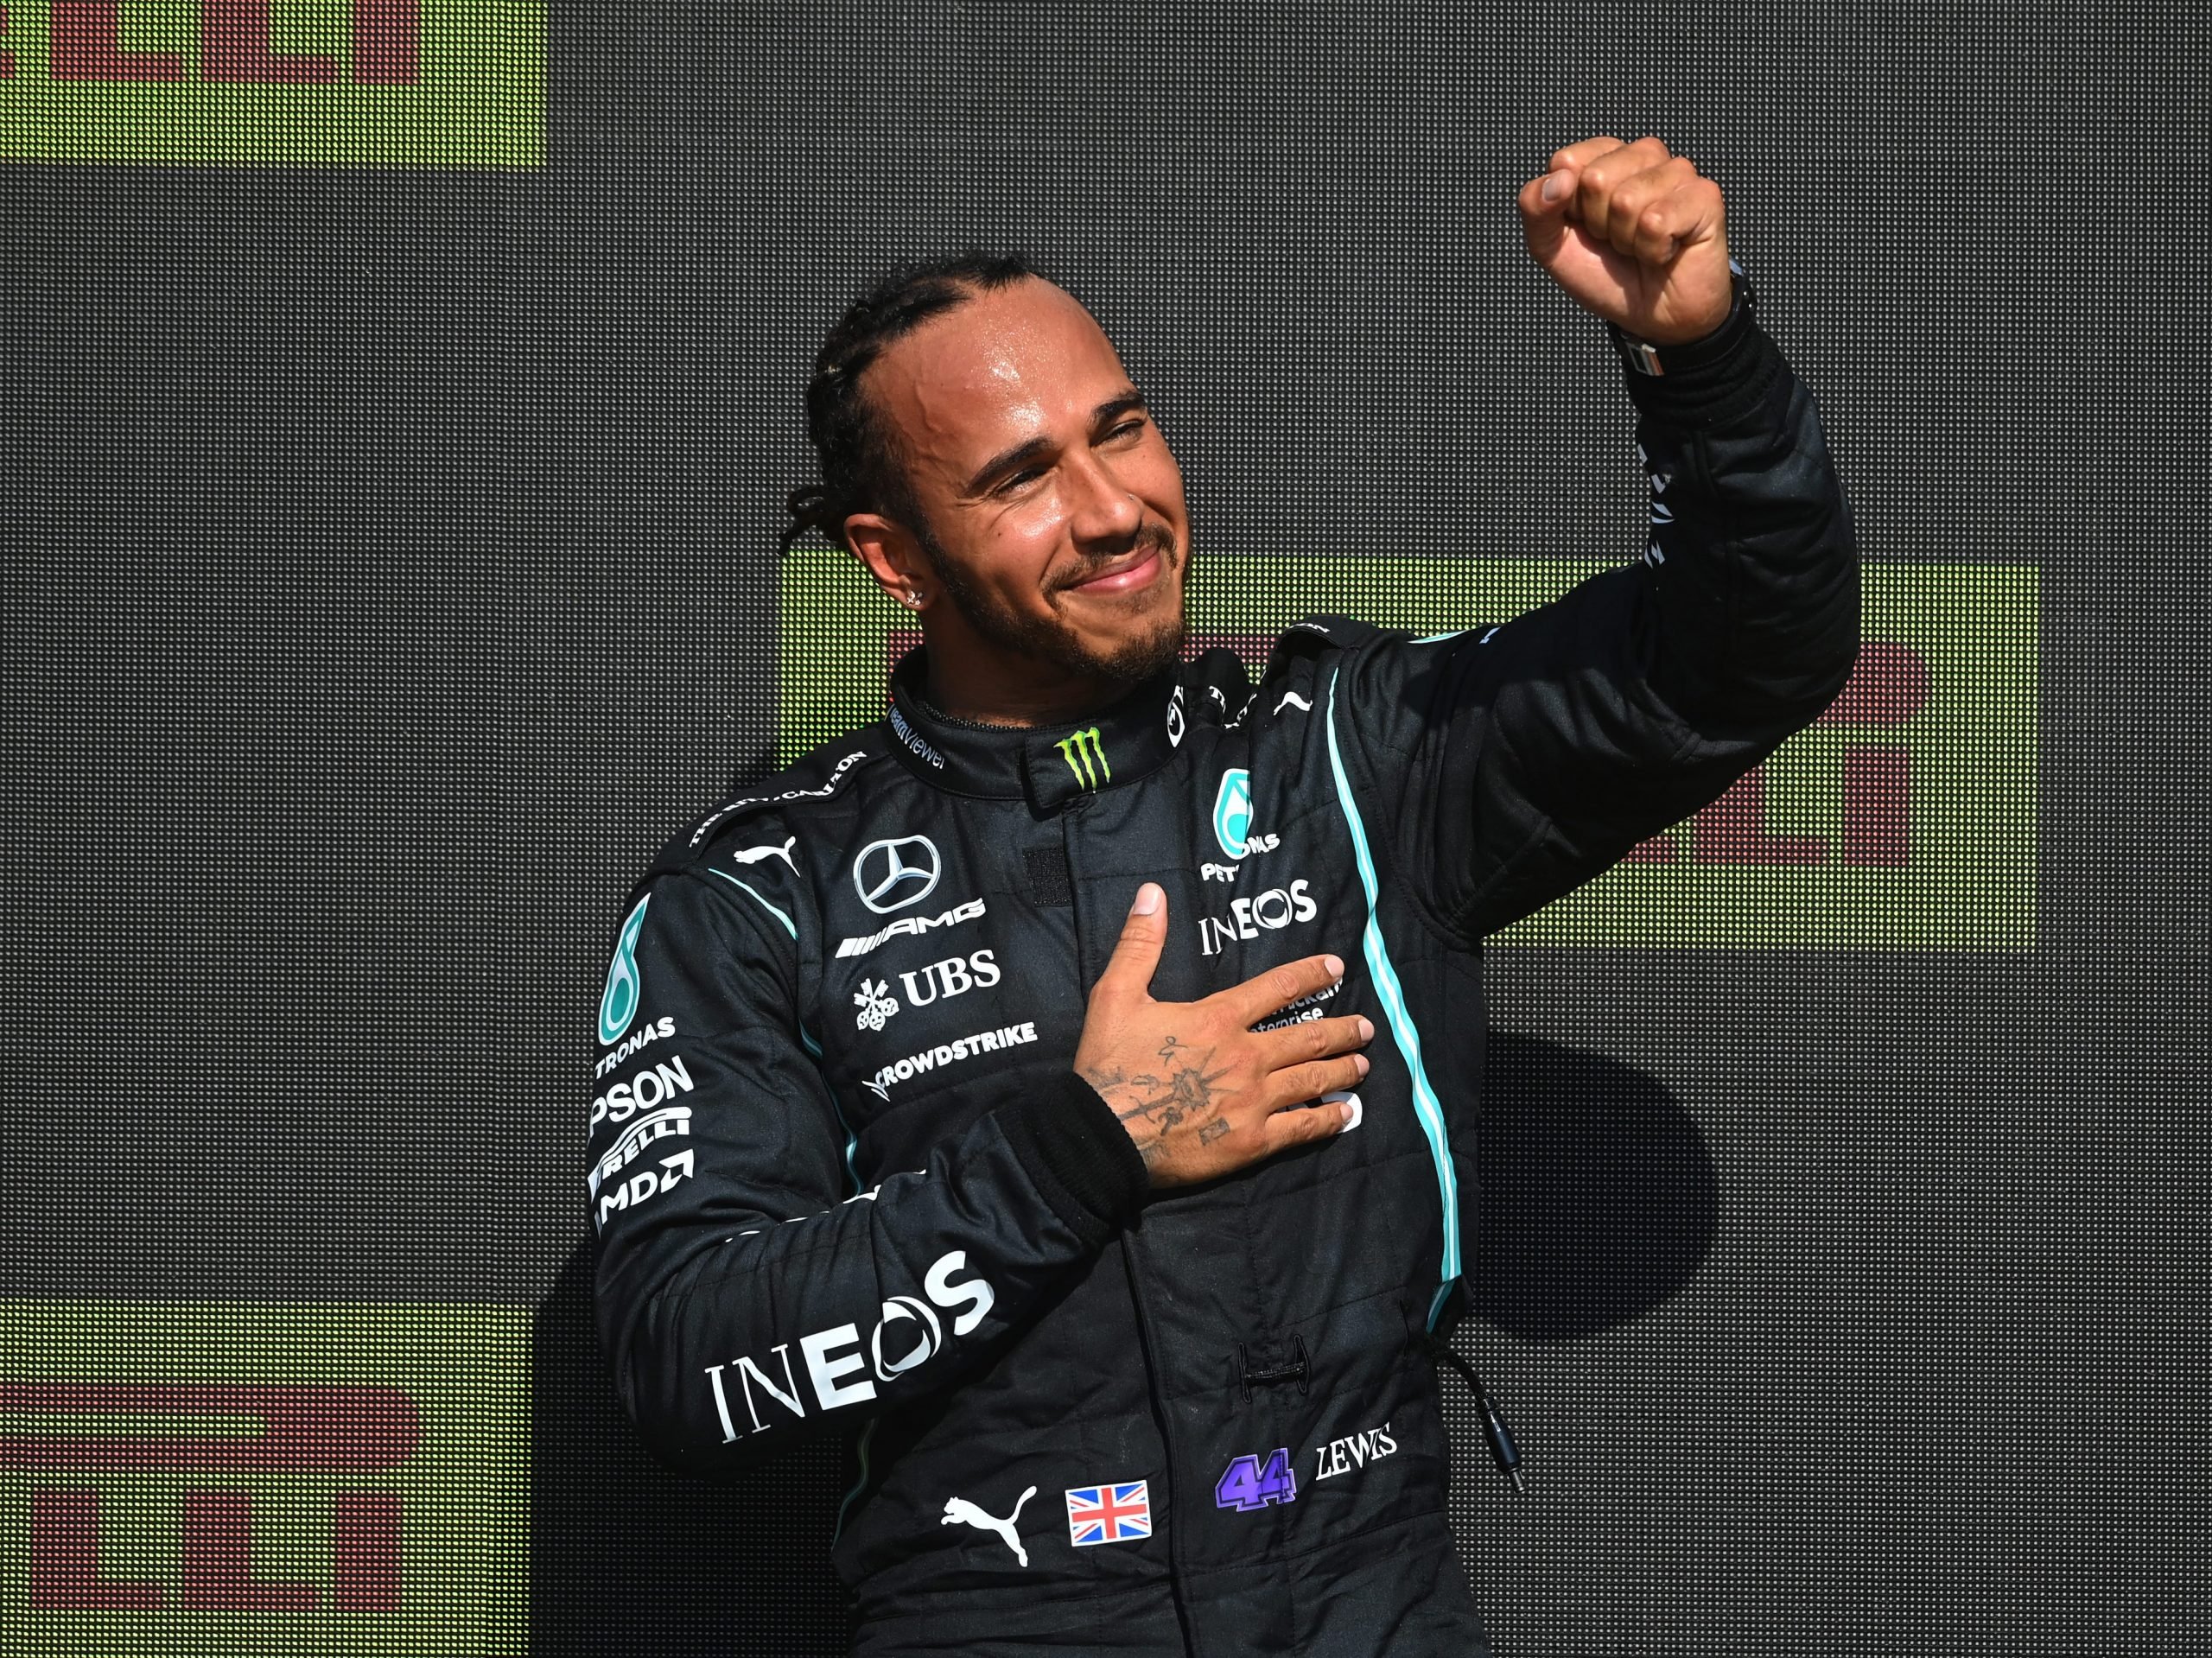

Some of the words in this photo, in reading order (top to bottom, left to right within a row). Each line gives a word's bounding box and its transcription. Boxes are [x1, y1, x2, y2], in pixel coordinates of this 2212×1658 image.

[1198, 879, 1318, 956] INEOS
[899, 949, 1001, 1007] UBS
[594, 1016, 676, 1080] TRONAS
[874, 1021, 1039, 1089] CROWDSTRIKE
[588, 1054, 695, 1145] PSON
[704, 1249, 995, 1445] INEOS
[1215, 1447, 1297, 1512] 44
[1315, 1421, 1398, 1482] LEWIS
